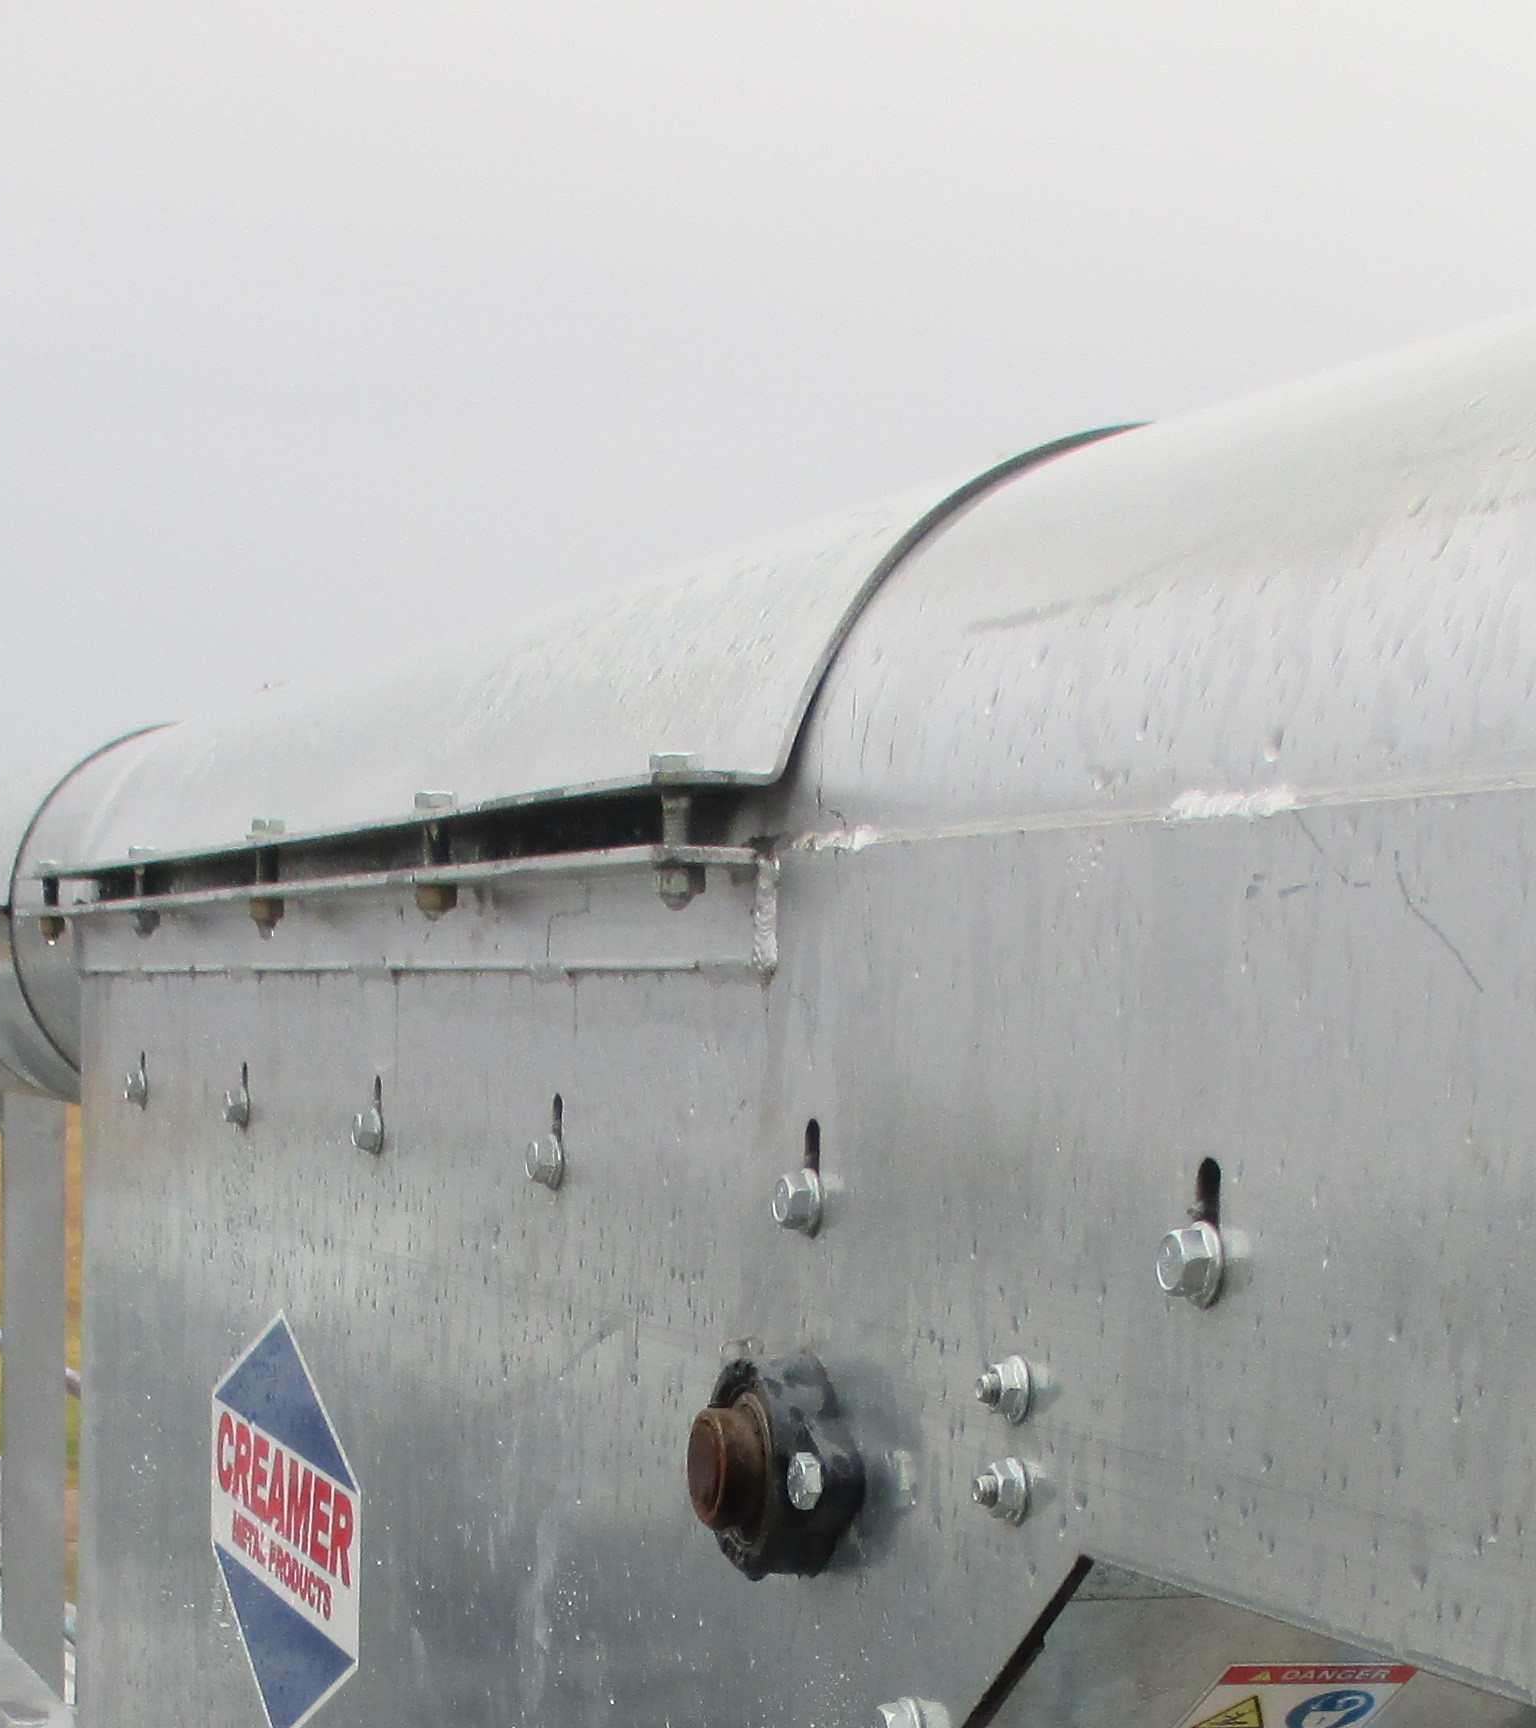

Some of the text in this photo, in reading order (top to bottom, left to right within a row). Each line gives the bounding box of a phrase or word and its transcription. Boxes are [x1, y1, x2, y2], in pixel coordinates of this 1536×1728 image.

[217, 1411, 353, 1589] CREAMER
[231, 1510, 332, 1621] METAL PRODUCTS
[1280, 1668, 1392, 1681] DANGER
